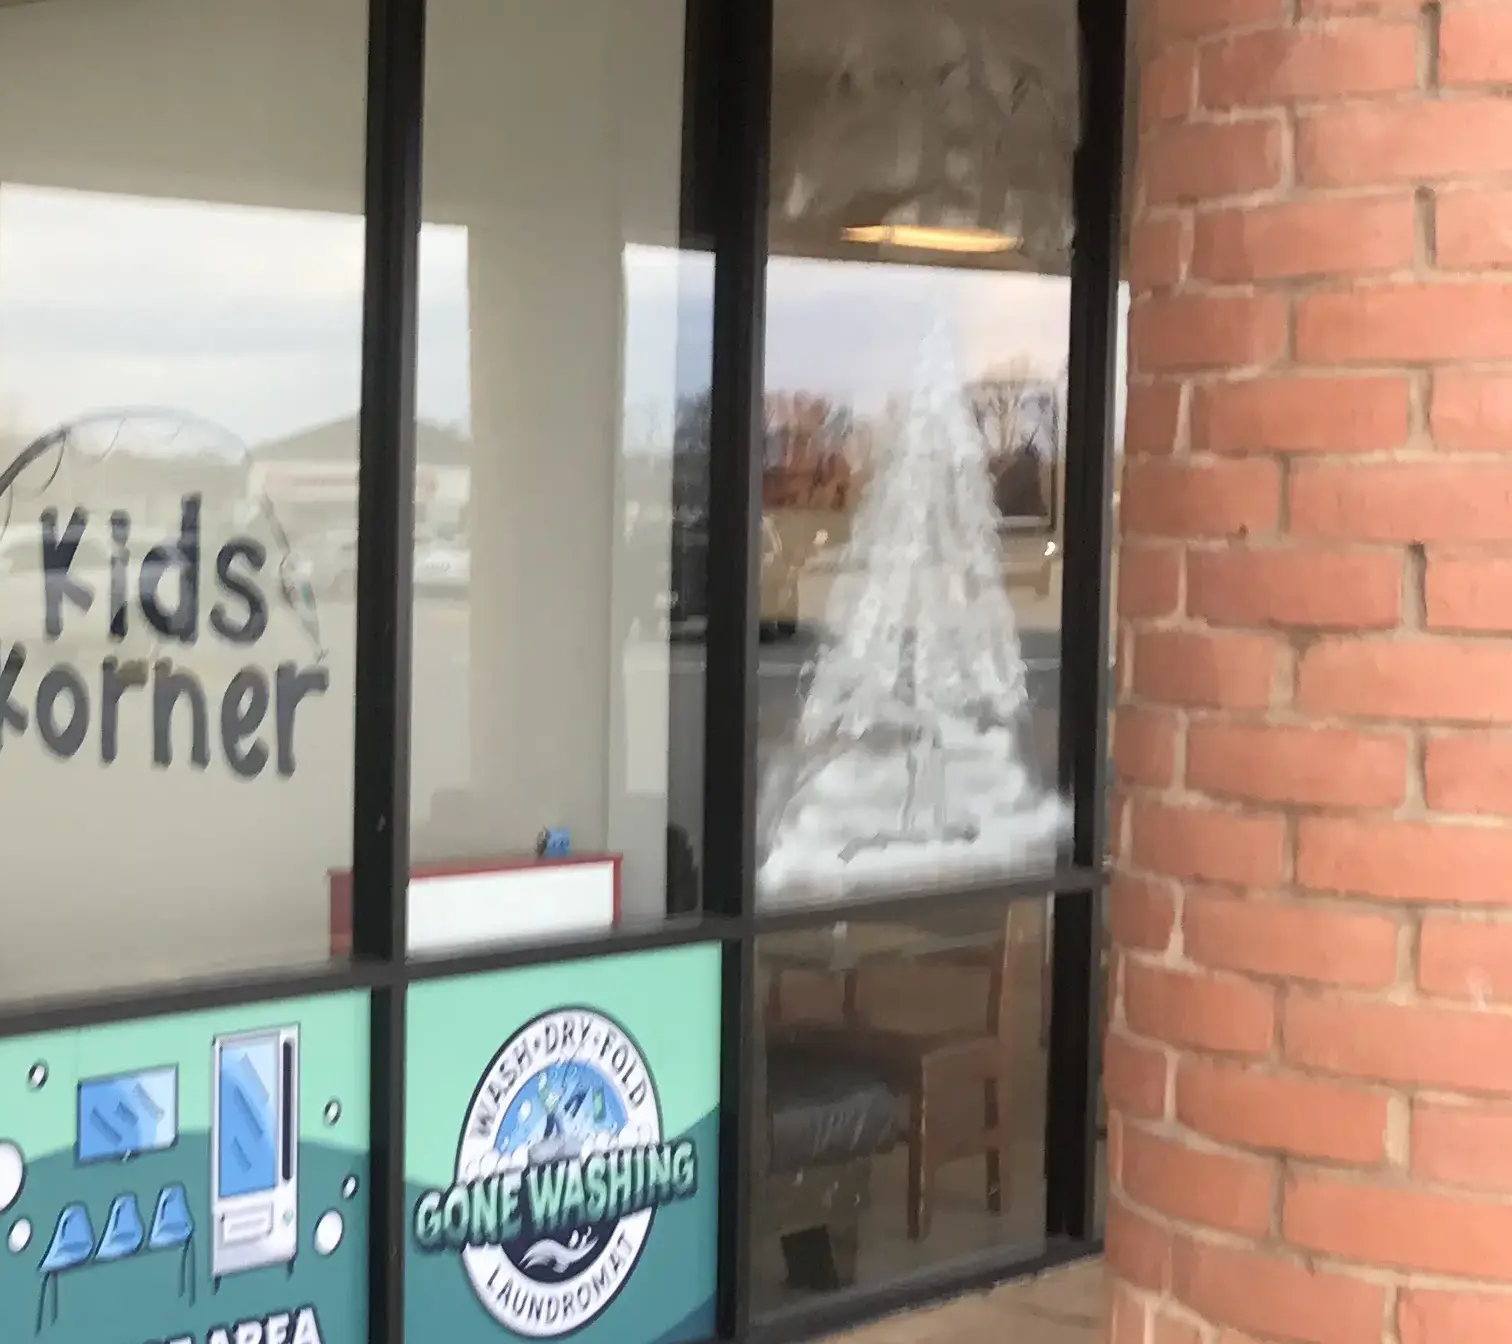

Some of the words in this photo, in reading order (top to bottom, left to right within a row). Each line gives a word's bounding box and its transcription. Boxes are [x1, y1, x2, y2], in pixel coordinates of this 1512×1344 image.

[40, 492, 269, 643] Kids
[416, 1174, 521, 1246] GONE
[527, 1142, 695, 1234] WASHING
[486, 1231, 635, 1326] LAUNDROMAT
